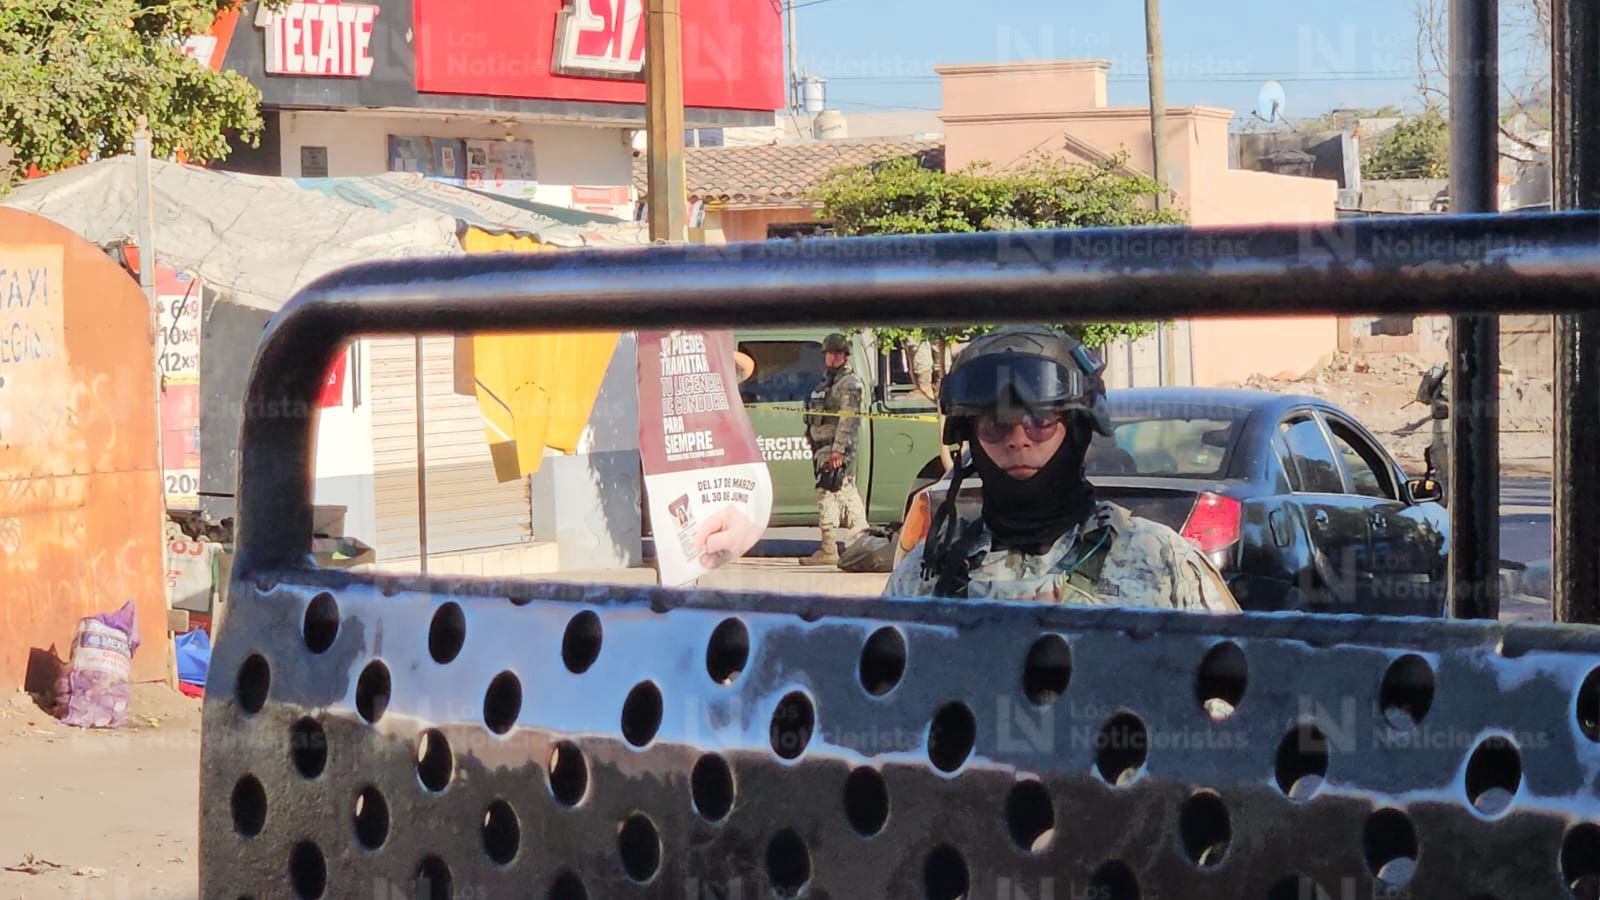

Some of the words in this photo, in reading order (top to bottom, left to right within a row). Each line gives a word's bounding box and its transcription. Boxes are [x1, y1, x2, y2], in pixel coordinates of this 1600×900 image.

[264, 2, 376, 75] TECATE
[661, 354, 710, 376] TRAMITAR
[673, 372, 725, 397] LICENCIA
[674, 393, 730, 414] CONDUCIR
[663, 415, 685, 435] PARA
[664, 430, 714, 454] SIEMPRE
[697, 480, 712, 491] DEL
[713, 478, 723, 489] 17
[724, 478, 732, 488] DE
[732, 478, 756, 491] MARZO
[701, 493, 711, 504] AL
[712, 492, 722, 503] 30
[723, 491, 731, 501] DE
[731, 491, 749, 503] JUNIO
